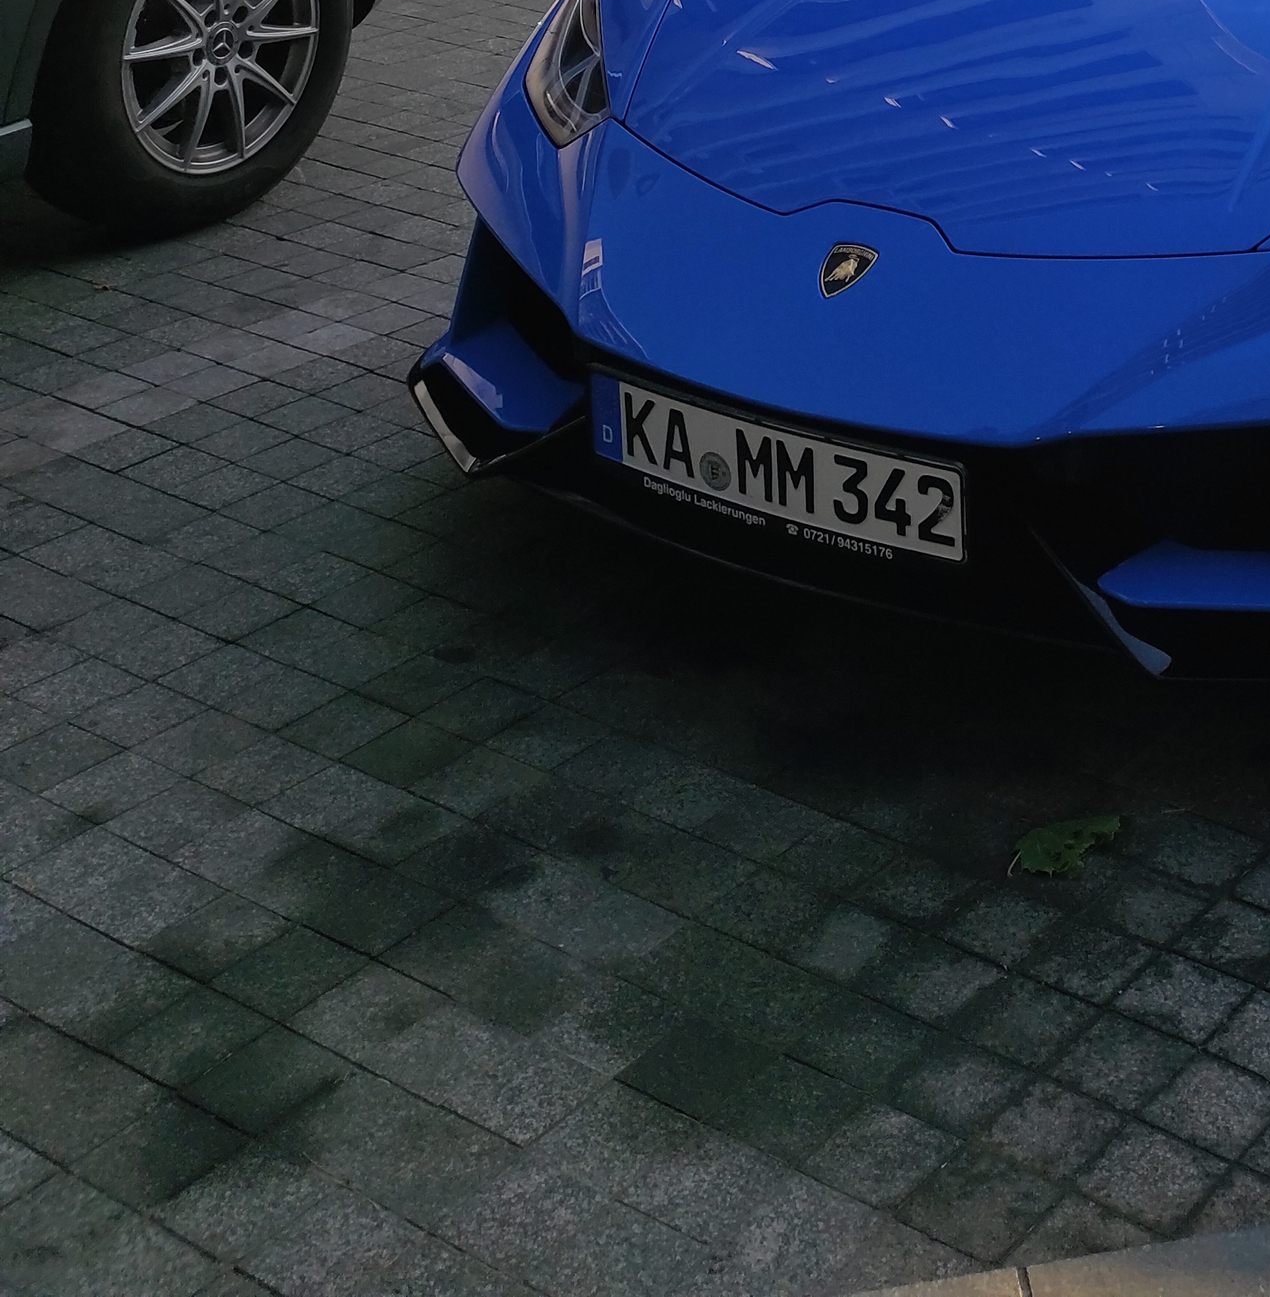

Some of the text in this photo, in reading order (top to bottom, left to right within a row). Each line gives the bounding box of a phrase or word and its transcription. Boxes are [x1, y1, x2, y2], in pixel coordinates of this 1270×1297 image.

[602, 426, 614, 444] D
[624, 392, 956, 547] KA MM 342
[643, 476, 766, 526] Daglioglu Lackierungen
